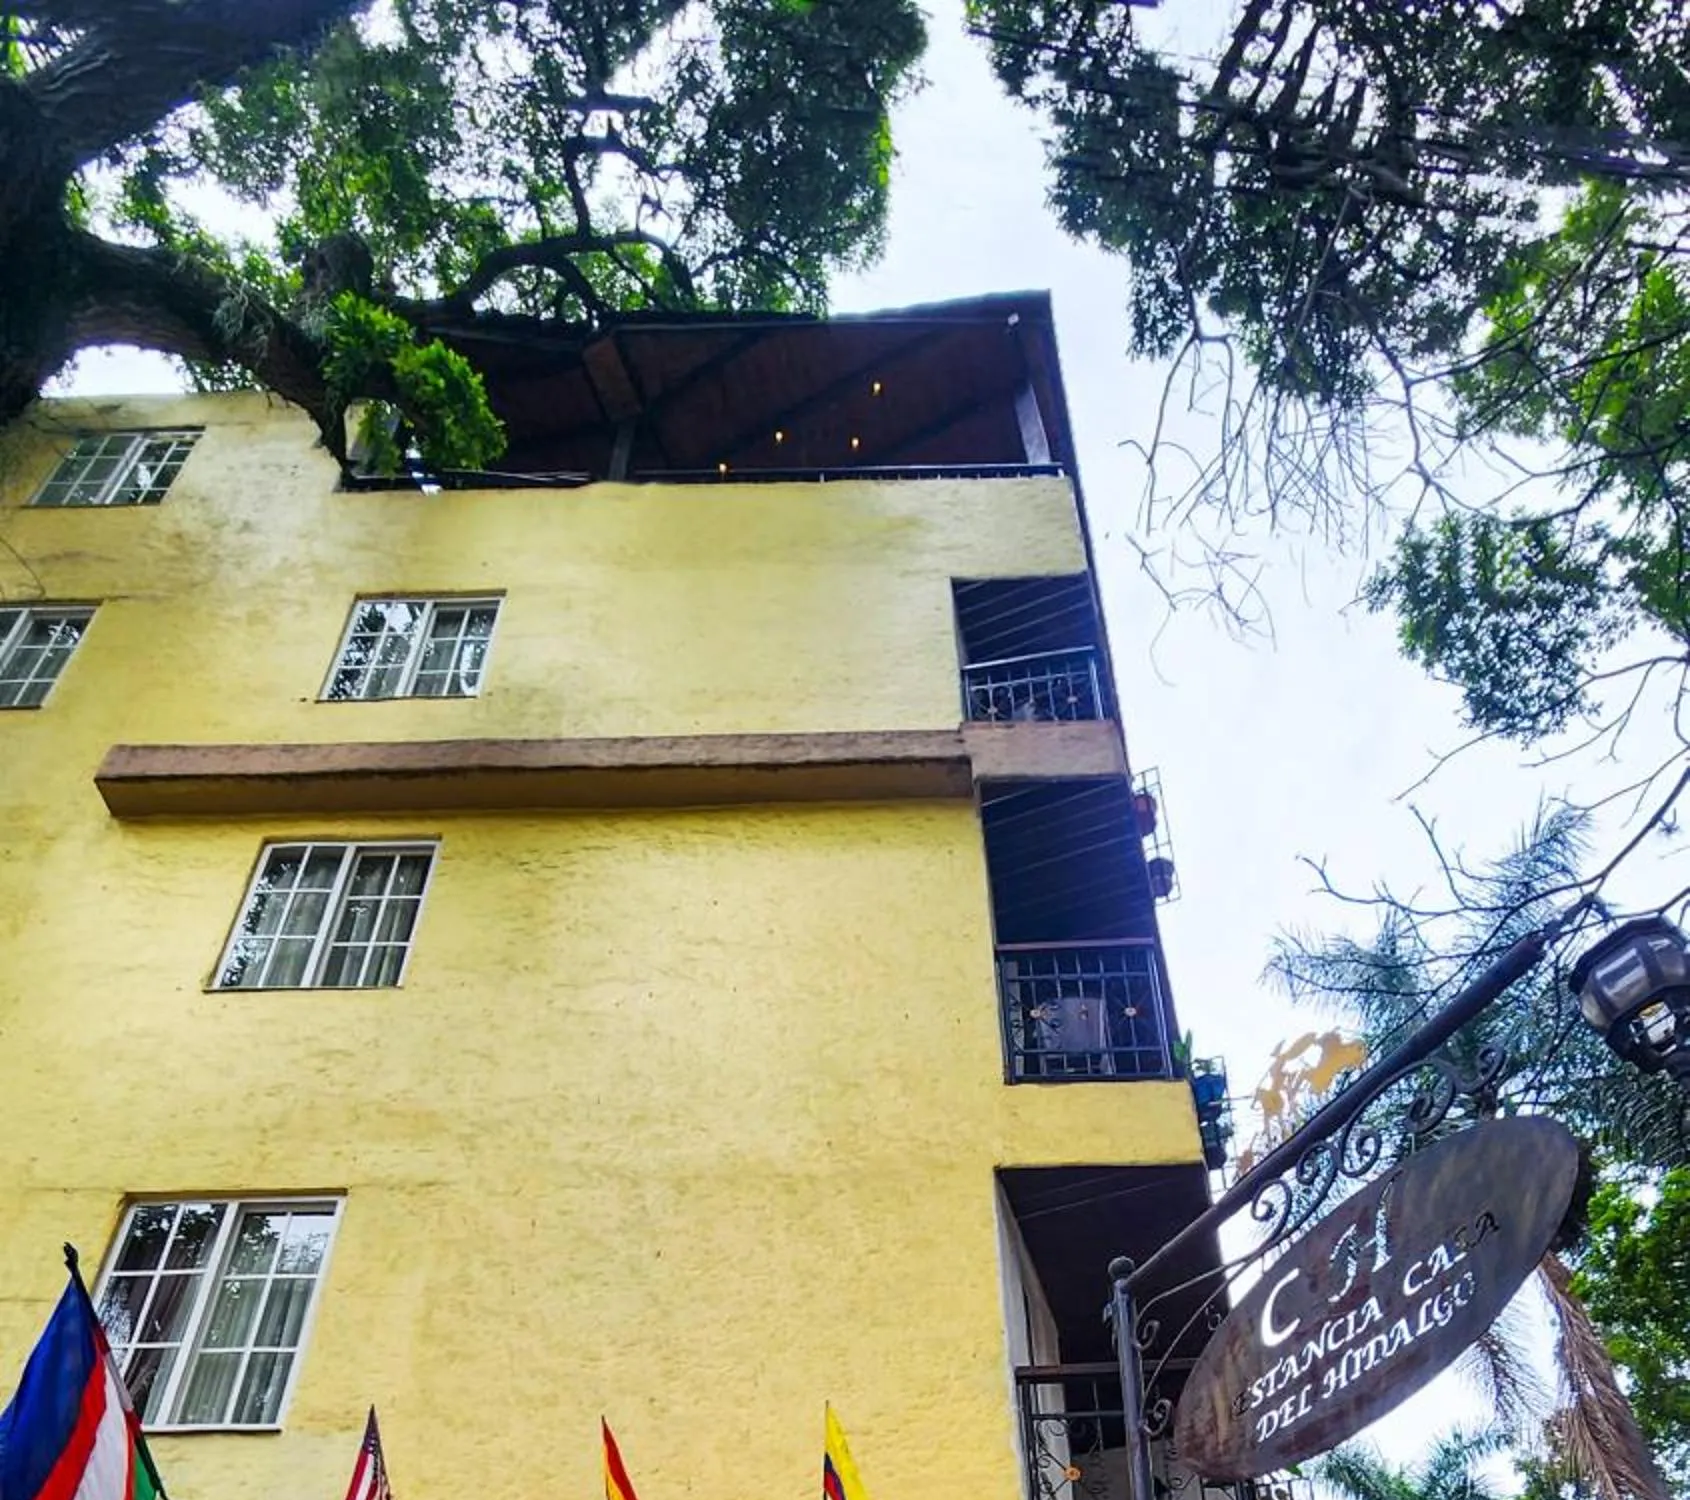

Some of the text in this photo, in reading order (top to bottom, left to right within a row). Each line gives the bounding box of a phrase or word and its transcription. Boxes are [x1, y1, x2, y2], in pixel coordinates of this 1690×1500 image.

[1231, 1209, 1500, 1417] ESTANCIA CASA
[1255, 1269, 1476, 1444] DEL HIDALGO
